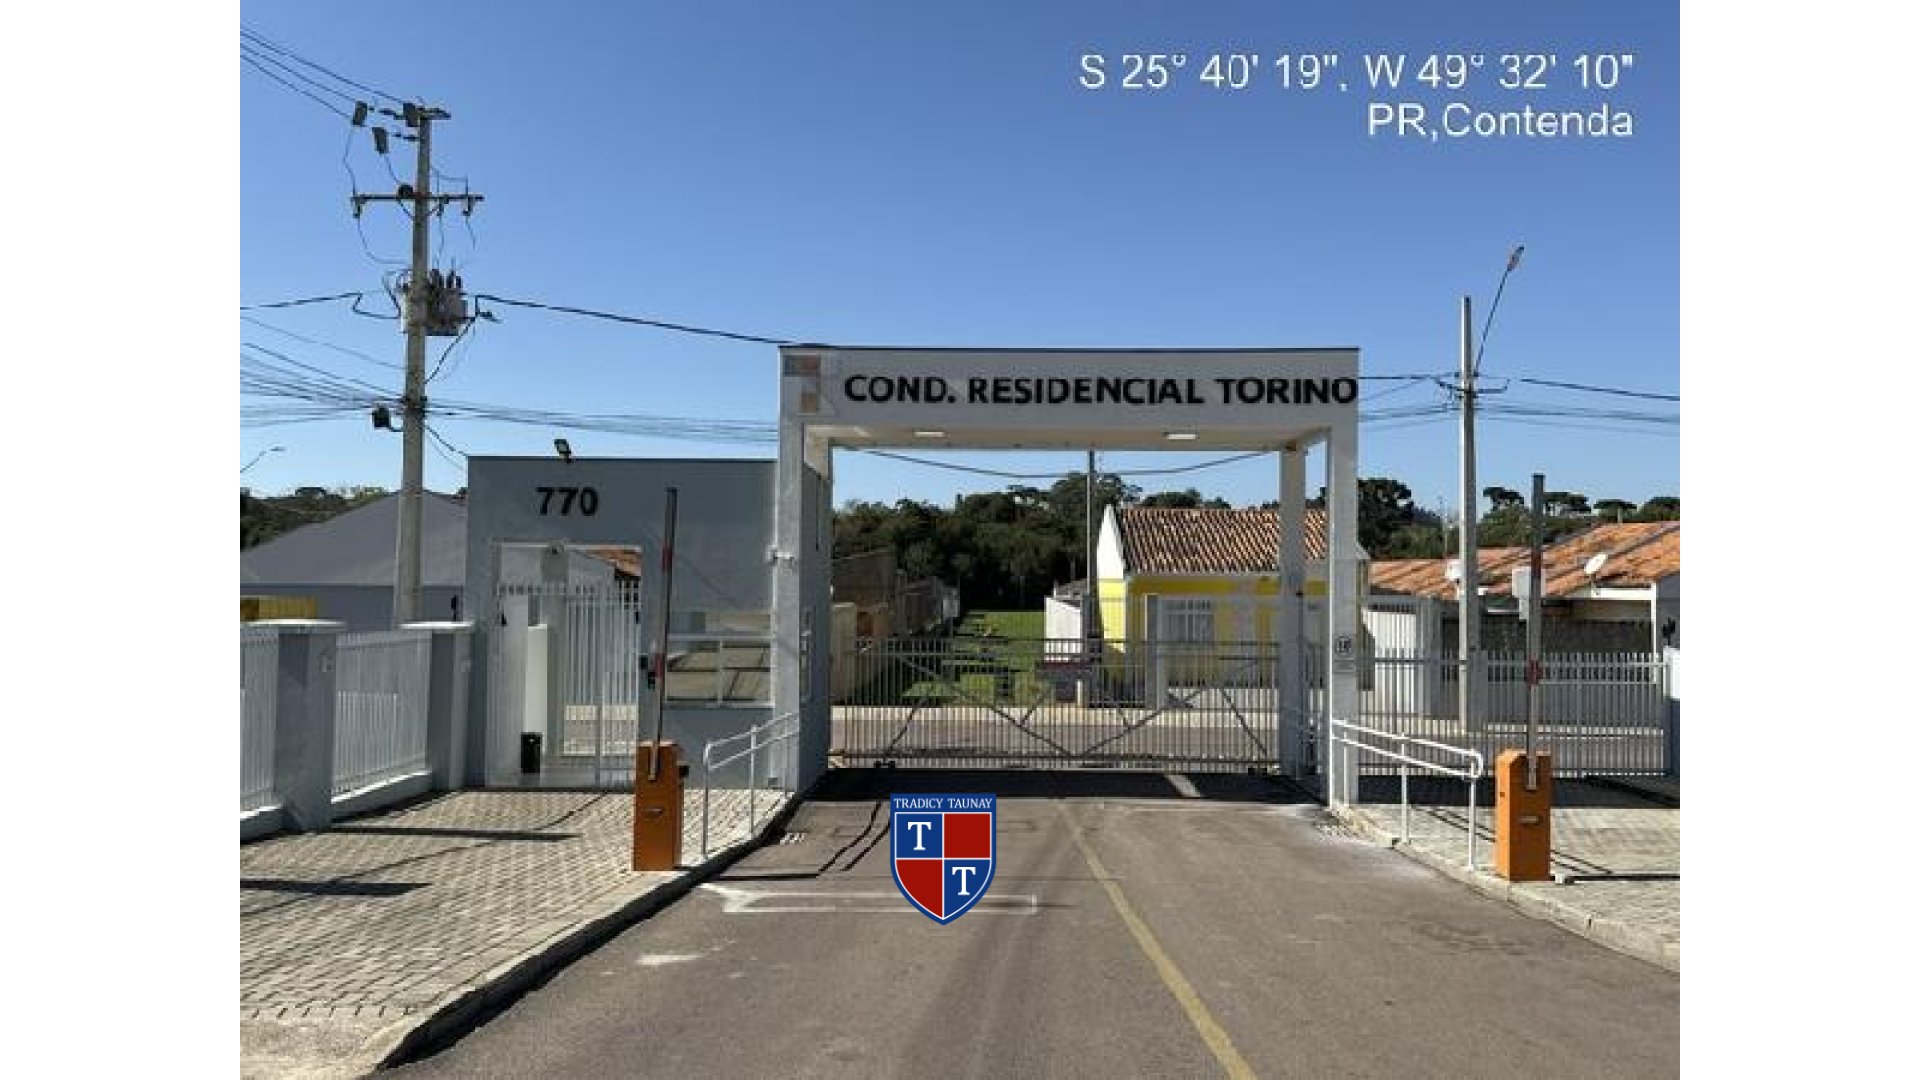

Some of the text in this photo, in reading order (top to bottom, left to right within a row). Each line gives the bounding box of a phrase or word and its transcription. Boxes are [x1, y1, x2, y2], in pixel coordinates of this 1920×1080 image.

[844, 374, 1359, 405] COND. RESIDENCIAL TORINO
[535, 485, 599, 518] 770
